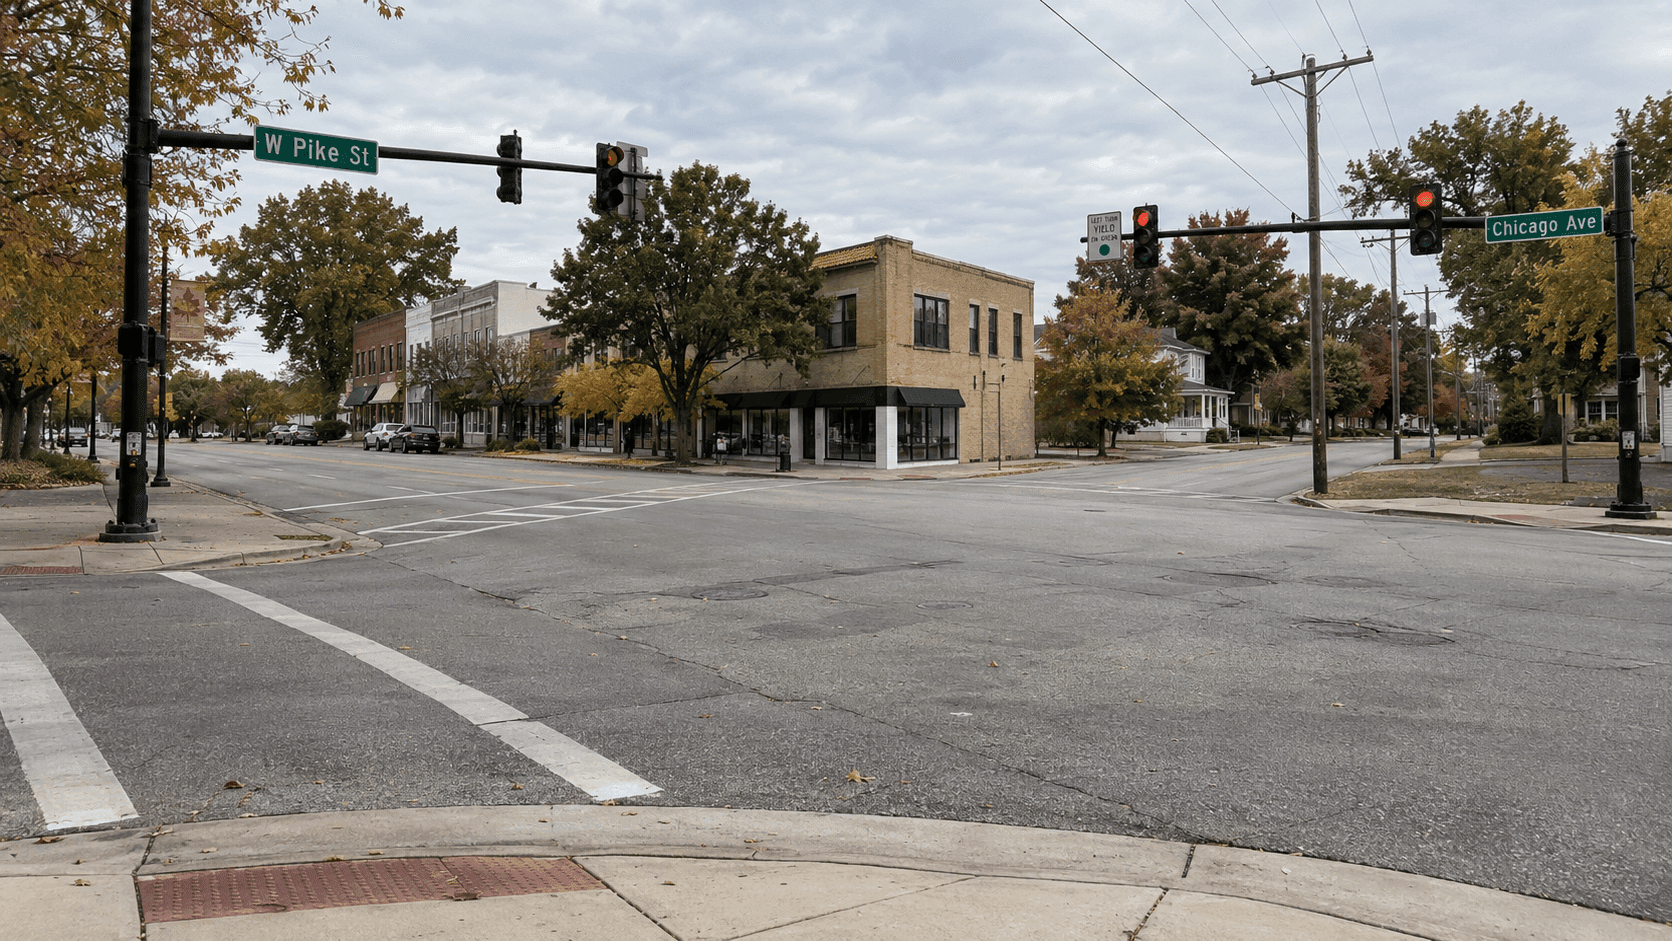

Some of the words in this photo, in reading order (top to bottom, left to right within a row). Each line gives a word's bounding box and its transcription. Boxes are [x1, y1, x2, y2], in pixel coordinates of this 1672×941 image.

[265, 132, 282, 155] W
[293, 137, 339, 162] Pike
[350, 145, 369, 166] St
[1493, 219, 1558, 237] Chicago
[1566, 215, 1596, 231] Ave
